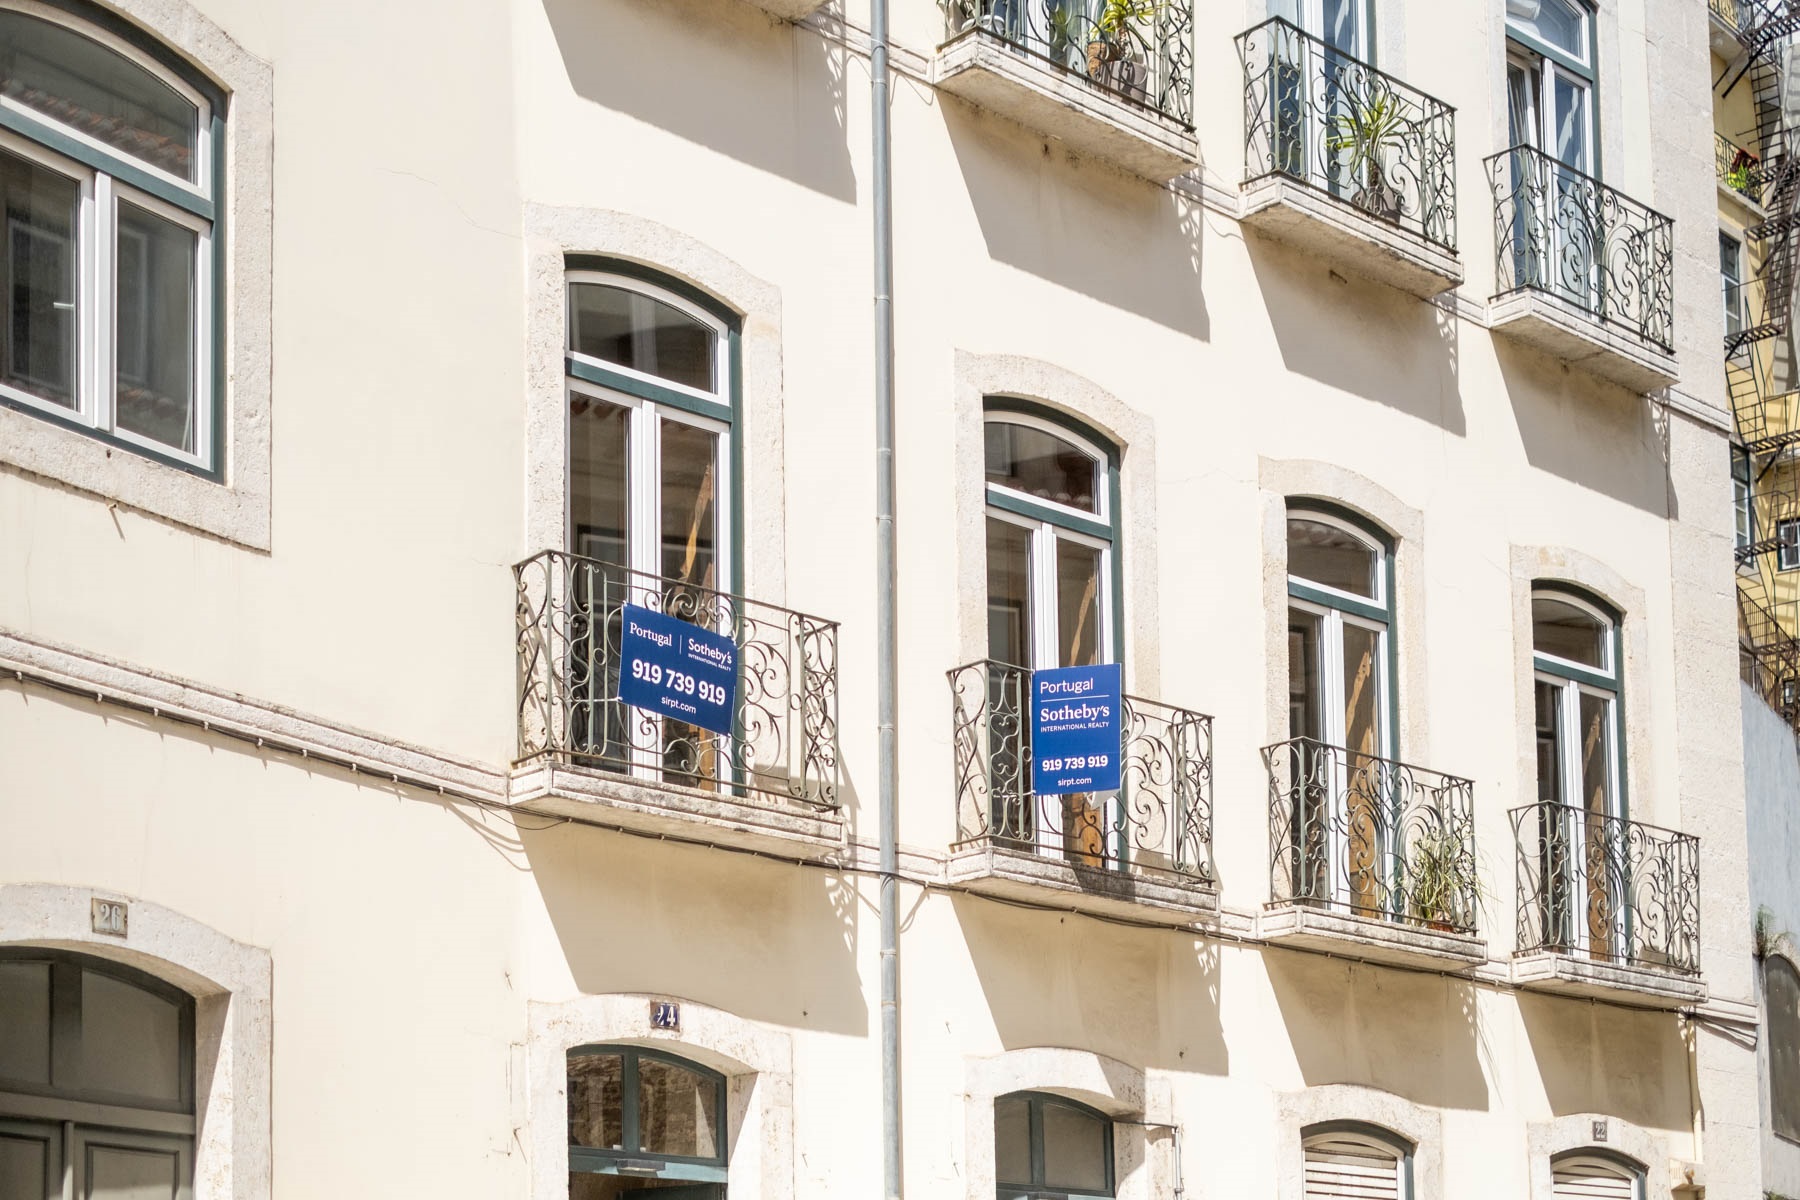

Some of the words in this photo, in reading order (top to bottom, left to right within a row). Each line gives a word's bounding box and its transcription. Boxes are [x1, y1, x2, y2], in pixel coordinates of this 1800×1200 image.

[629, 621, 673, 647] Portugal
[688, 638, 732, 665] Sotheby's
[632, 659, 662, 685] 919
[665, 668, 695, 695] 739
[698, 680, 726, 706] 919
[1040, 677, 1094, 694] Portugal
[661, 696, 697, 714] sirpt.com
[1040, 703, 1110, 722] Sotheby's
[1040, 723, 1087, 733] INTERNATIONAL
[1087, 721, 1109, 729] REALTY
[1042, 759, 1062, 771] 919
[1064, 757, 1086, 770] 739
[1087, 755, 1109, 768] 919
[1057, 777, 1092, 787] sirpt.com
[100, 903, 121, 931] 26
[1595, 1122, 1606, 1139] 22
